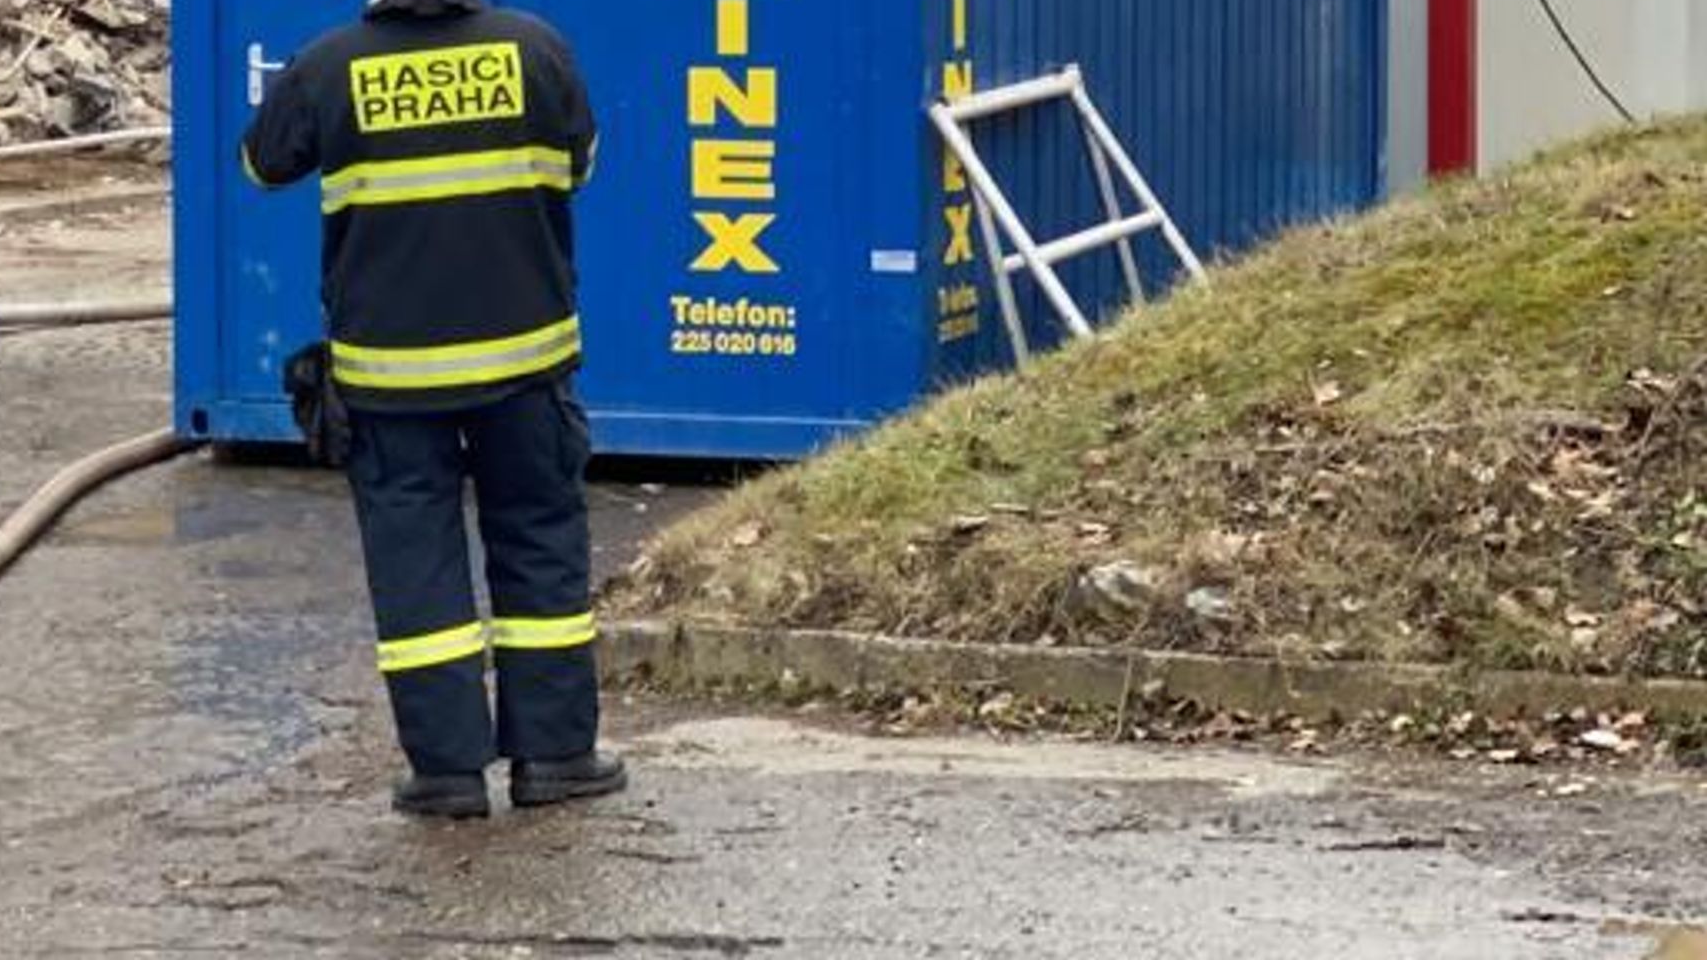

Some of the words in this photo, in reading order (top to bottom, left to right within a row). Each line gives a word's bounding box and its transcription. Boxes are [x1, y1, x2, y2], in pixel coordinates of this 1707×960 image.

[363, 84, 516, 126] PRAHA
[670, 295, 796, 327] Telefon:
[670, 329, 711, 353] 225
